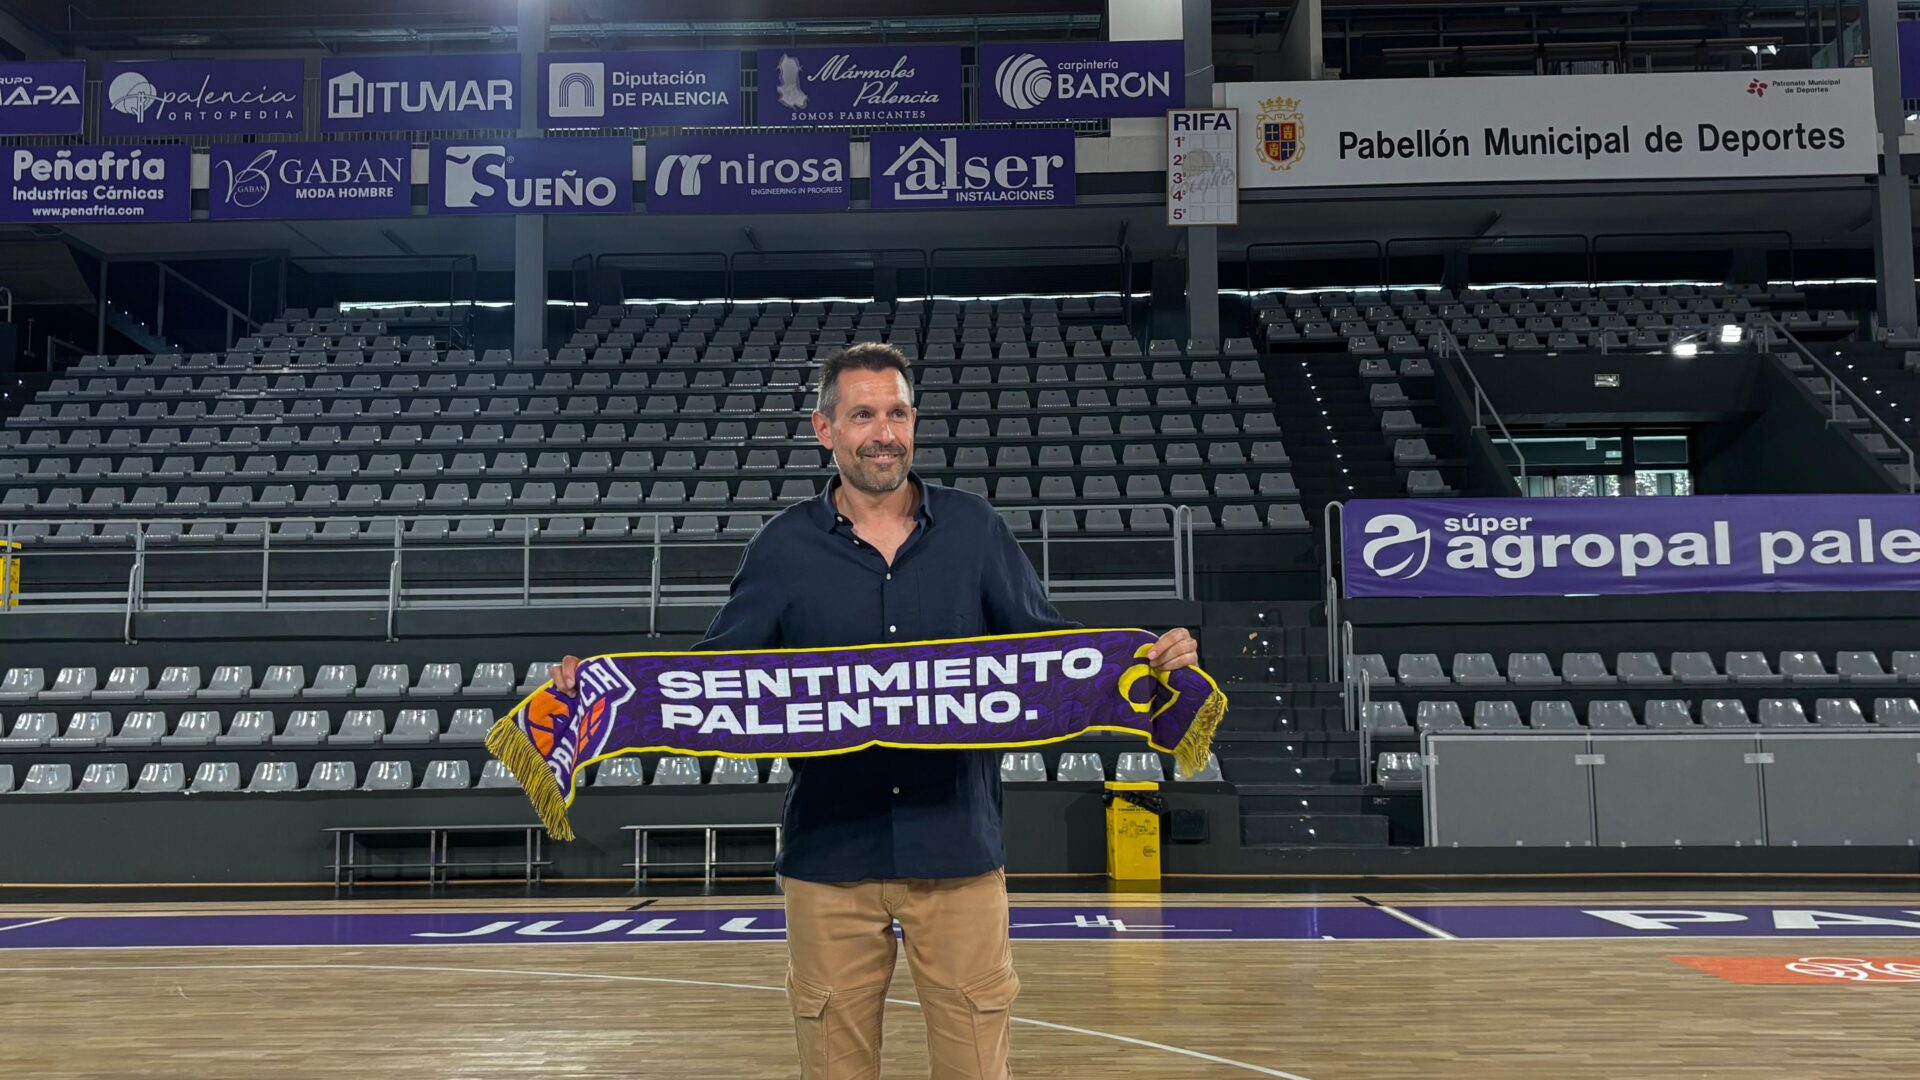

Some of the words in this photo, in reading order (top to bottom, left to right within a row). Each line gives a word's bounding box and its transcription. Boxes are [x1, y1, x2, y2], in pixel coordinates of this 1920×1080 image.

[807, 54, 915, 80] Mármoles
[1057, 58, 1119, 72] carpintería
[612, 70, 706, 88] Diputación
[1808, 78, 1841, 86] Municipal
[0, 85, 81, 106] APA
[153, 74, 297, 121] palencia
[329, 76, 513, 117] HITUMAR
[612, 92, 636, 107] DE
[641, 91, 729, 106] PALENCIA
[852, 80, 940, 107] Palencia
[1796, 86, 1829, 94] Deportes
[168, 109, 294, 121] ORTOPEDIA
[791, 112, 833, 121] SOMOS
[839, 110, 926, 120] FABRICANTES
[1173, 113, 1232, 132] RIFA
[1339, 128, 1470, 160] Pabellón
[1484, 124, 1630, 160] Municipal
[1644, 124, 1683, 154] de
[1698, 122, 1845, 158] Deportes
[13, 149, 165, 182] Peñafría
[279, 157, 405, 185] GABAN
[720, 153, 843, 185] nirosa
[902, 137, 1064, 191] alser
[238, 185, 265, 193] GABAN
[471, 153, 617, 208] SUEÑO
[12, 186, 88, 201] Industrias
[93, 185, 164, 201] Cárnicas
[295, 188, 335, 199] MODA
[338, 187, 394, 198] HOMBRE
[750, 187, 796, 196] ENGINEERING
[798, 187, 806, 195] IN
[807, 186, 843, 195] PROGRESS
[955, 191, 1055, 202] INSTALACIONES
[32, 205, 145, 219] www.penafria.com
[1444, 513, 1533, 532] súper
[1445, 520, 1731, 579] agropal
[657, 647, 1104, 701] SENTIMIENTO
[660, 692, 1039, 736] PALENTINO.
